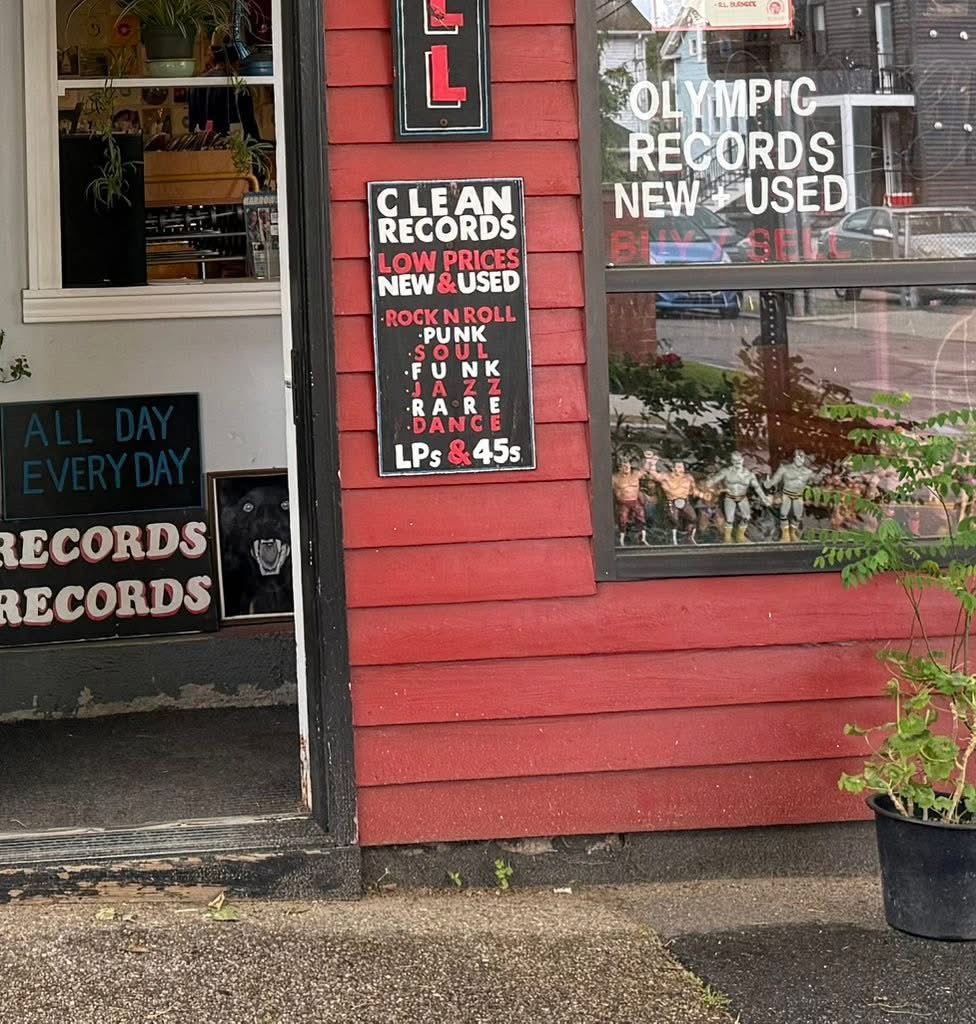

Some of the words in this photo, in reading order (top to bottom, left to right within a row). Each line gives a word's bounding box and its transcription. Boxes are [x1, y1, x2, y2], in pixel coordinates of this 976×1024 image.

[629, 77, 817, 121] OLYMPIC
[628, 131, 836, 172] RECORDS
[377, 186, 512, 217] CLEAN
[614, 180, 700, 219] NEW
[745, 175, 848, 215] USED
[378, 214, 517, 244] RECORDS
[609, 229, 695, 264] BUY
[746, 228, 852, 263] SELL
[378, 251, 437, 274] LOW
[443, 248, 520, 271] PRICES
[377, 273, 435, 297] NEW
[437, 272, 457, 294] &
[457, 270, 520, 294] USED
[385, 308, 439, 327] ROCK
[443, 308, 460, 325] N
[464, 305, 516, 324] ROLL
[424, 325, 487, 344] PUNK
[414, 343, 488, 361] SOUL
[412, 360, 500, 381] FUNK
[412, 378, 502, 397] JAZZ
[412, 396, 501, 417] RARE
[24, 409, 94, 448] ALL
[115, 405, 174, 442] DAY
[412, 415, 502, 434] DANCE
[395, 440, 442, 469] LPs
[447, 439, 470, 466] &
[472, 437, 521, 465] 45s
